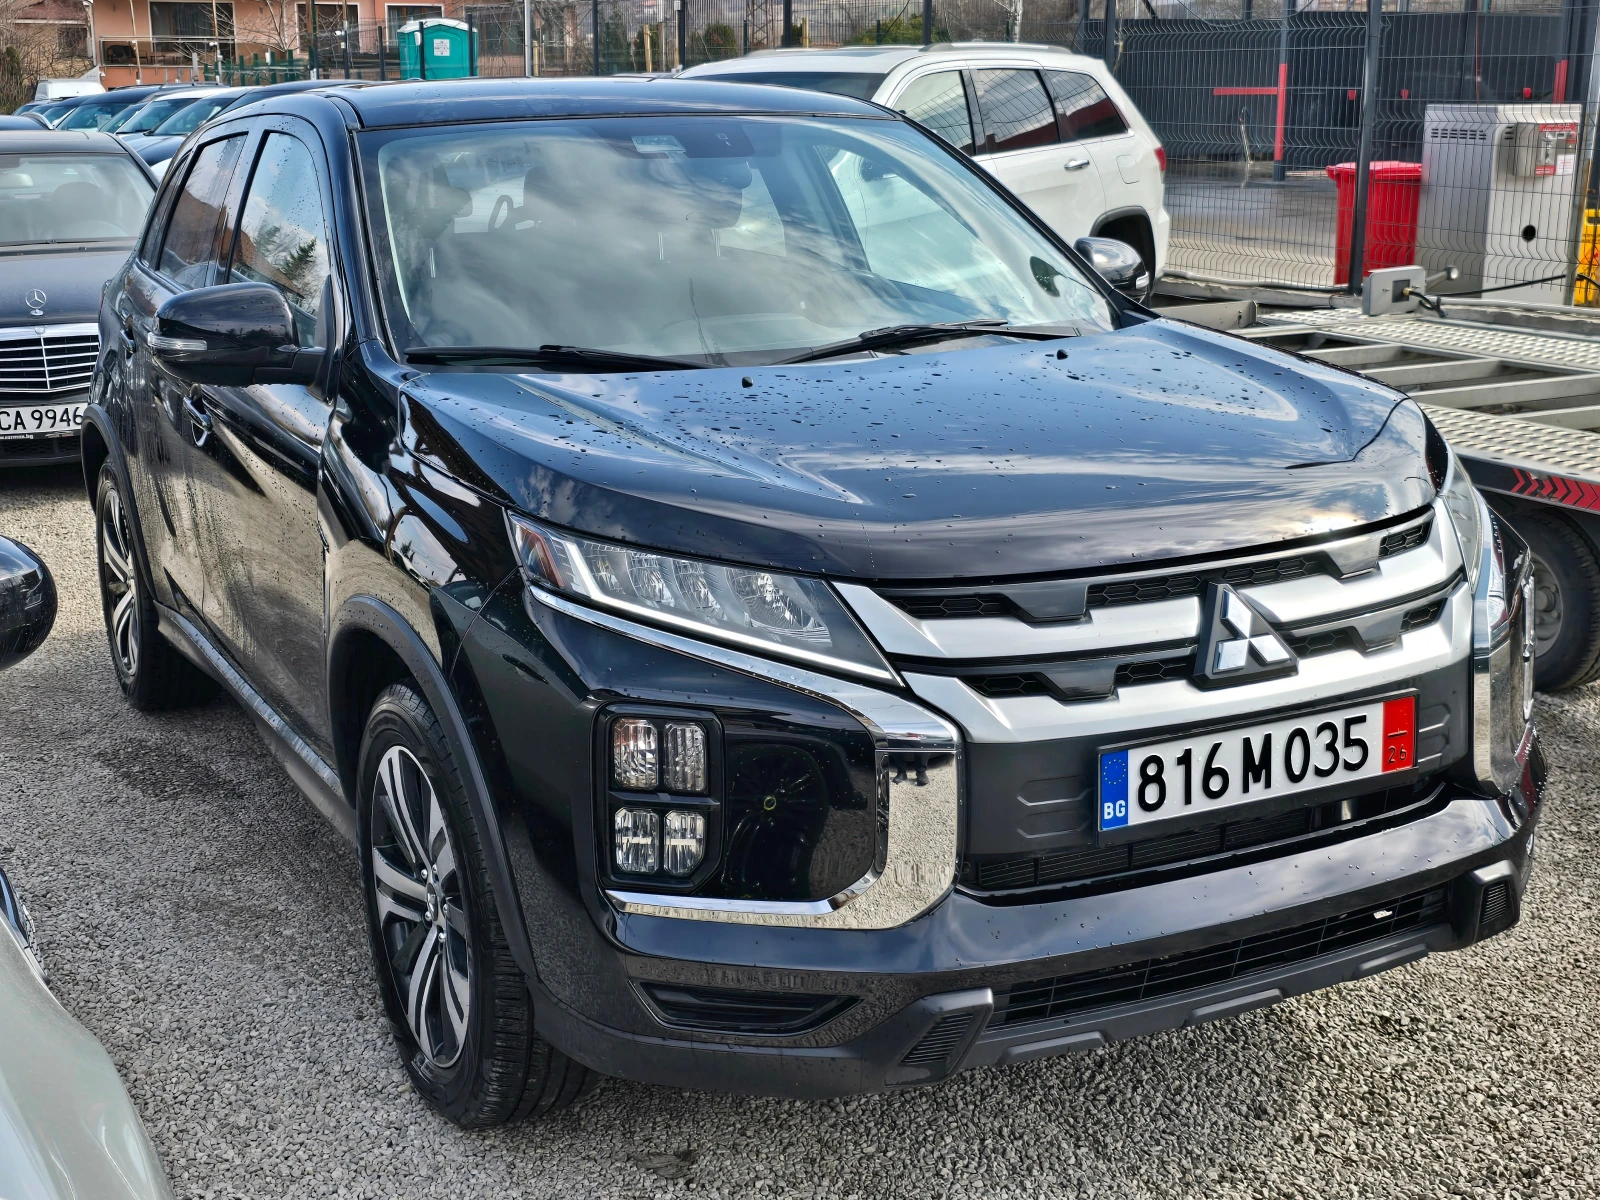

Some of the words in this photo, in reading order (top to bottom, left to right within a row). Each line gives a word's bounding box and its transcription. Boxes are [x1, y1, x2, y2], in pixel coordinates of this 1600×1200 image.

[0, 410, 26, 431] CA
[31, 407, 83, 429] 9946
[1387, 743, 1407, 764] 26
[1102, 800, 1126, 820] BG
